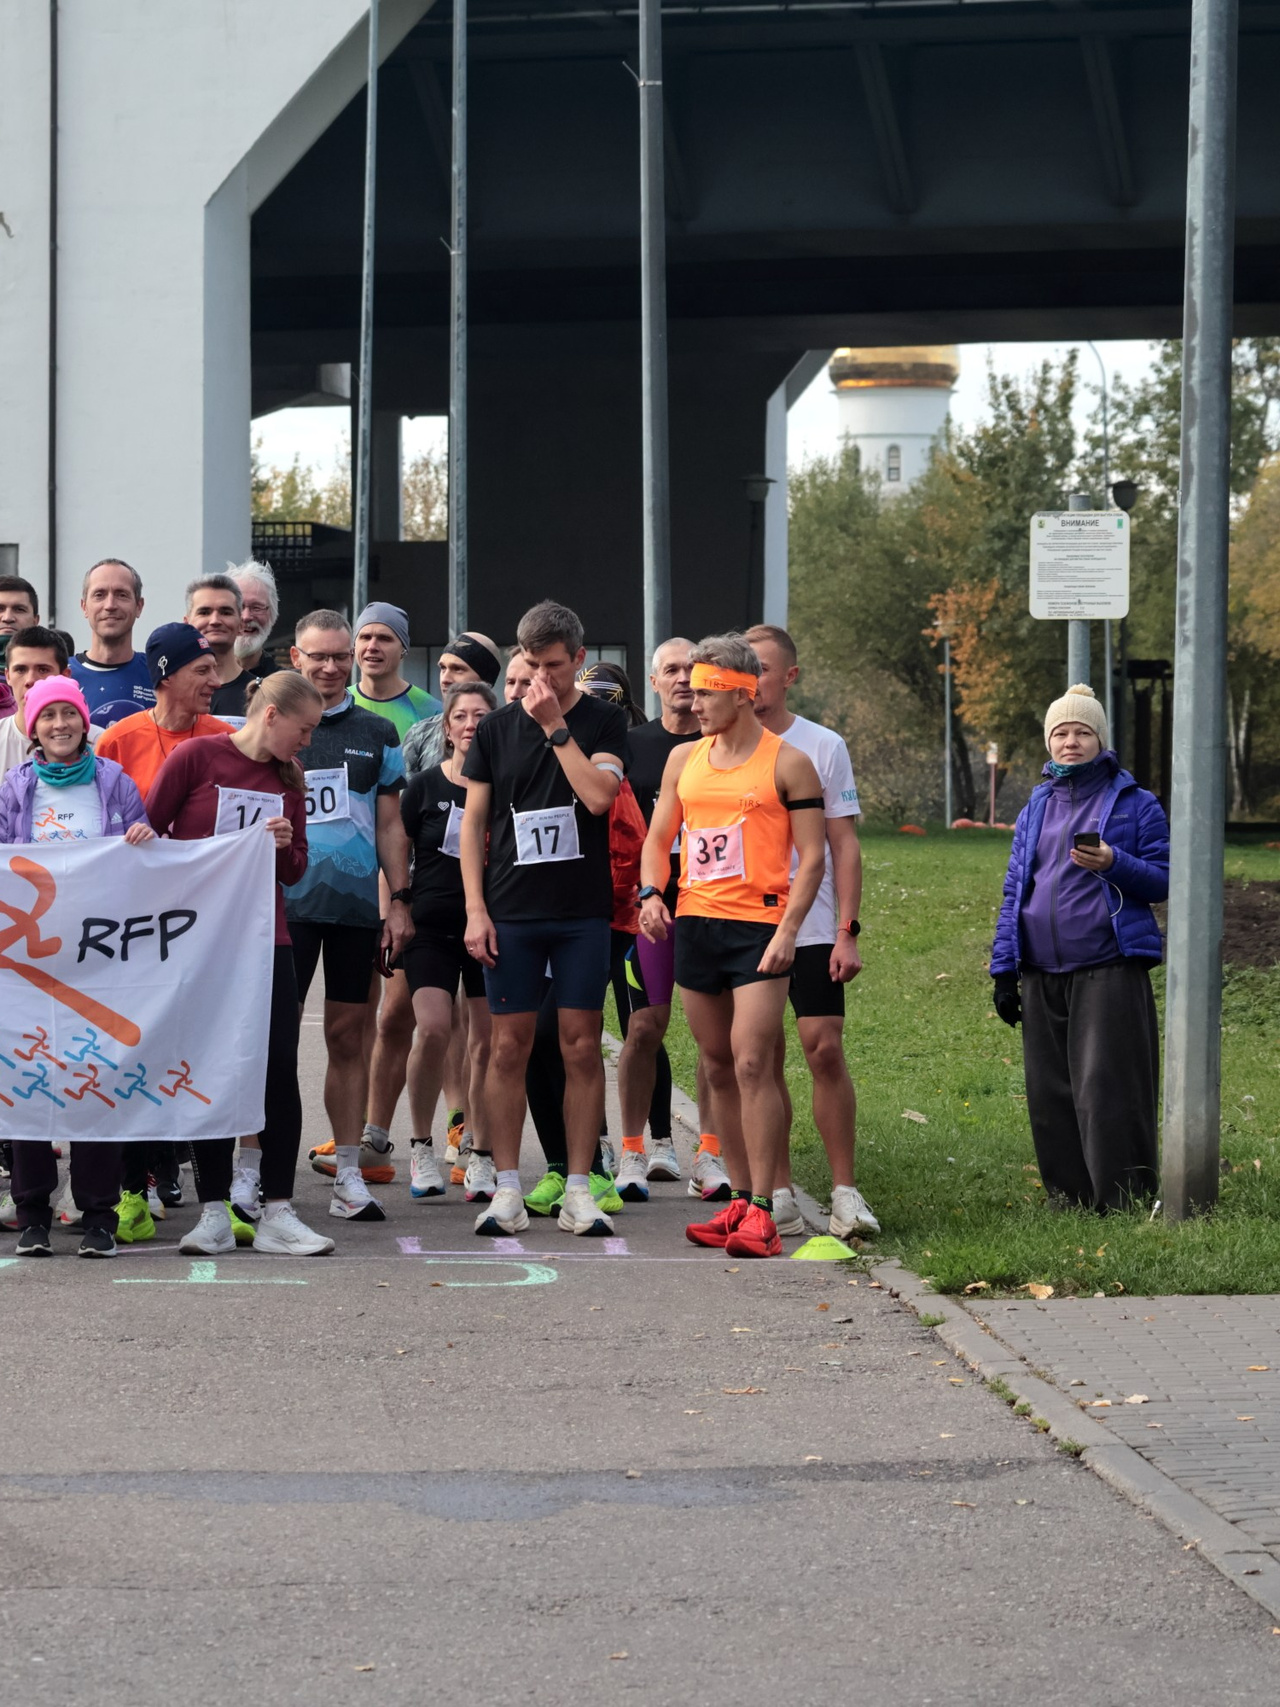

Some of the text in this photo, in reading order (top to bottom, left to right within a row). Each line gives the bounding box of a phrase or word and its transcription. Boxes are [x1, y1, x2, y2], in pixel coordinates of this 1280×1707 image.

[1061, 519, 1100, 527] ВНИМАНИЕ
[703, 679, 726, 689] TIRS
[739, 799, 761, 808] TIRS
[531, 825, 559, 855] 17
[77, 909, 197, 963] RFP
